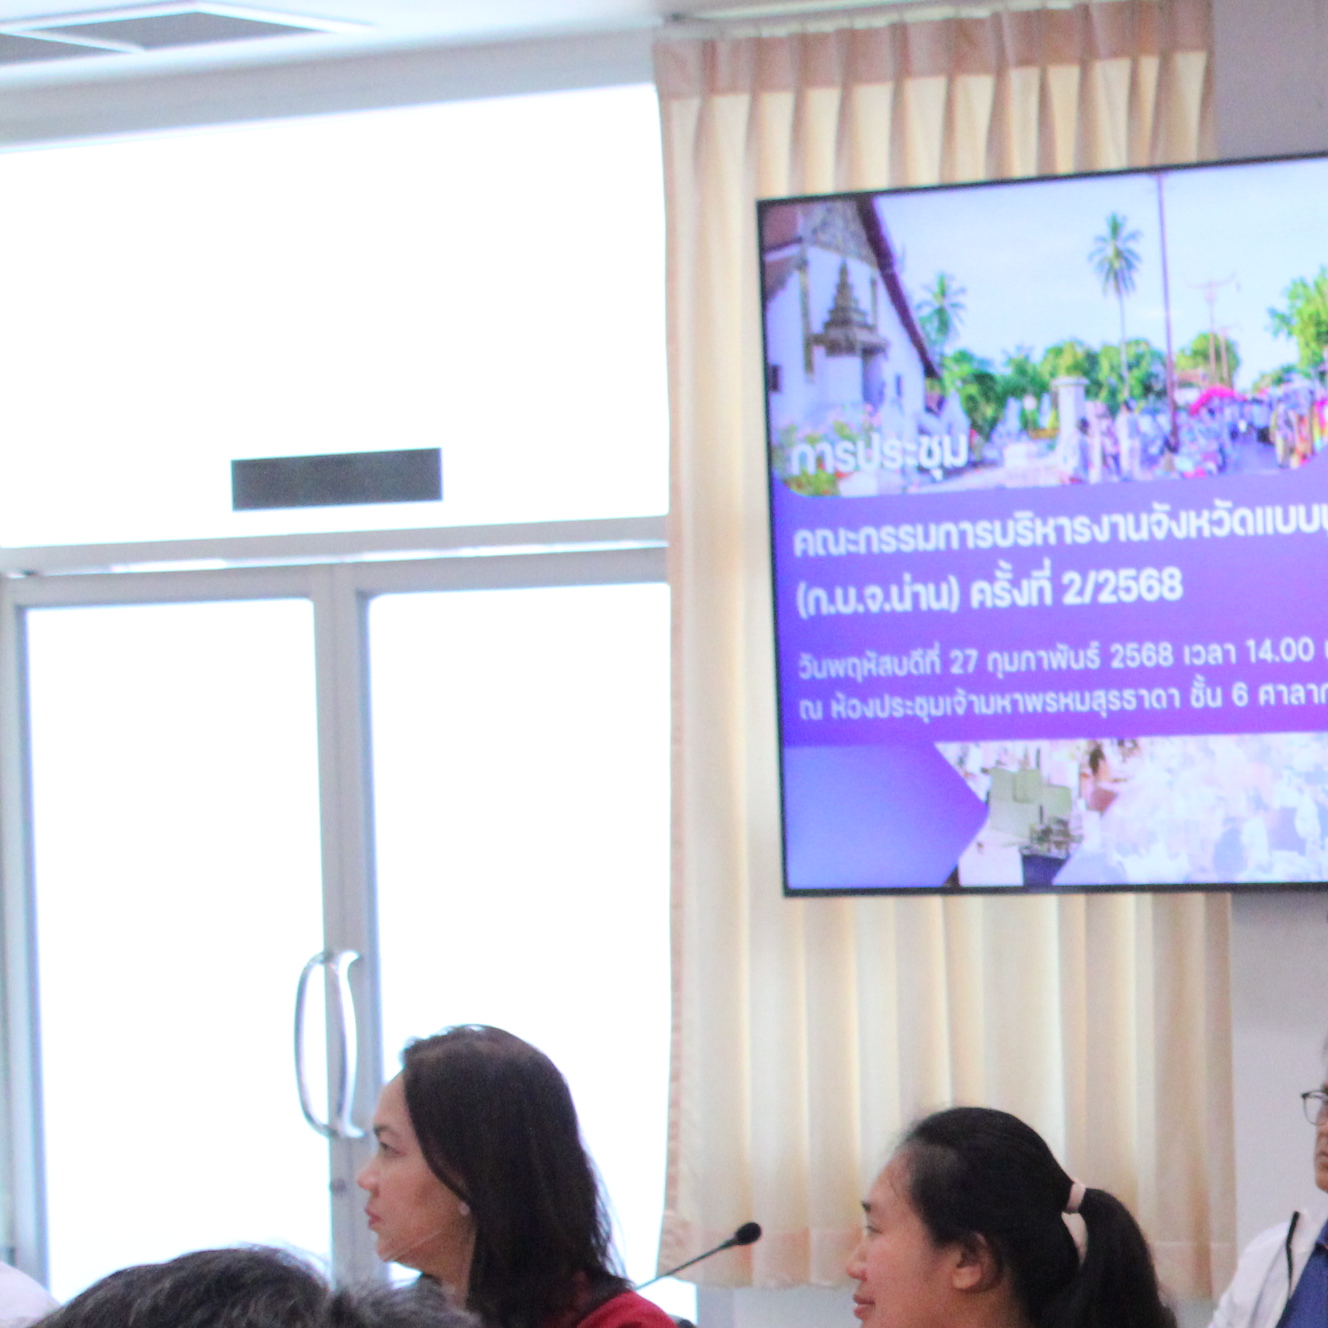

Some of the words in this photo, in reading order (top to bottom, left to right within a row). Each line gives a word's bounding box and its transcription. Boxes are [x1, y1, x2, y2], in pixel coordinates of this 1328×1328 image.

[791, 432, 969, 481] การประชุม
[970, 557, 1053, 609] ครั้งที่
[1061, 566, 1183, 605] 2/2568
[799, 641, 942, 683] วันพฤหัสบดีที่
[950, 649, 979, 674] 27
[987, 642, 1101, 680] กุมภาพันธ์
[1110, 643, 1174, 669] 2568
[1184, 642, 1237, 666] เวลา
[1246, 637, 1316, 664] 14.00
[799, 698, 823, 721] ณ
[831, 686, 1181, 724] ห้องประชุมเจ้ามหาพรหมสุรธาดา
[1190, 673, 1223, 709] ชั้น
[1231, 681, 1249, 708] 6
